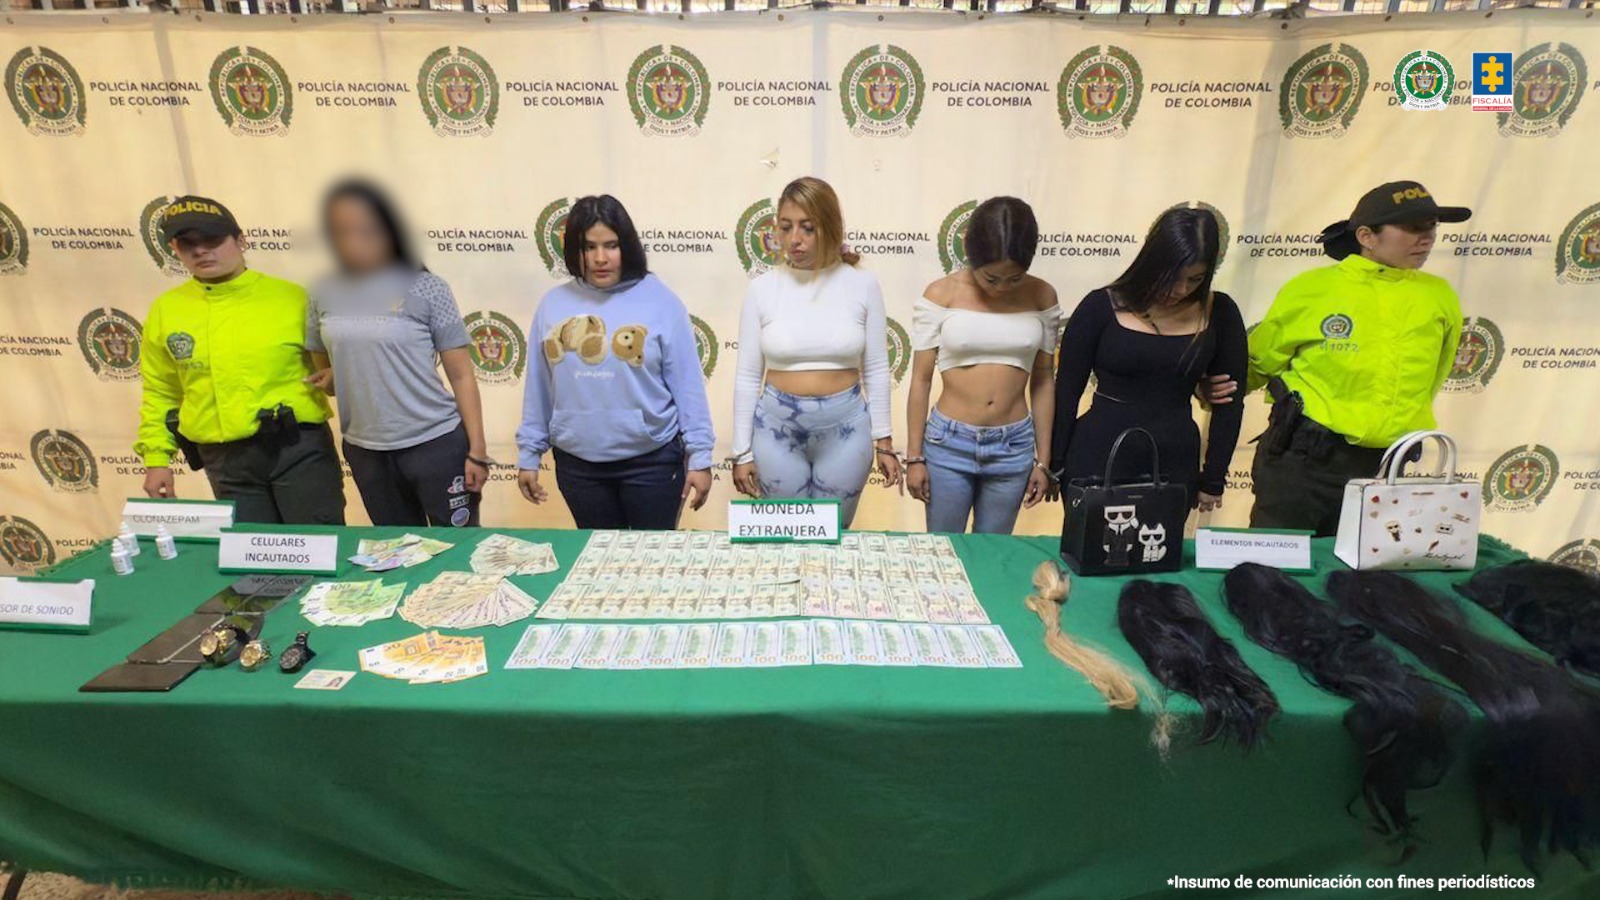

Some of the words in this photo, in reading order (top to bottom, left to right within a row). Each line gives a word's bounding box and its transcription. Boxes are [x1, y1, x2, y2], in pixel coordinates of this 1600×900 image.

[90, 80, 138, 91] POLICÍA
[141, 81, 202, 91] NACIONAL
[298, 80, 344, 92] POLICÍA
[348, 82, 410, 92] NACIONAL
[506, 80, 553, 92] POLICÍA
[556, 82, 618, 91] NACIONAL
[718, 79, 765, 91] POLICÍA
[769, 81, 831, 91] NACIONAL
[933, 79, 980, 92] POLICÍA
[985, 82, 1049, 92] NACIONAL
[1151, 80, 1201, 93] POLICÍA
[1204, 82, 1272, 93] NACIONAL
[110, 97, 125, 105] DE
[129, 96, 190, 105] COLOMBIA
[317, 97, 331, 106] DE
[334, 97, 396, 106] COLOMBIA
[524, 97, 538, 106] DE
[542, 96, 604, 106] COLOMBIA
[734, 97, 749, 106] DE
[753, 96, 816, 105] COLOMBIA
[948, 97, 963, 106] DE
[967, 97, 1032, 106] COLOMBIA
[1165, 99, 1181, 107] DE
[1185, 98, 1251, 107] COLOMBIA
[34, 226, 75, 236] POLICÍA
[79, 228, 134, 237] NACIONAL
[243, 228, 269, 238] LICÍA
[428, 228, 466, 239] OLICÍA
[469, 230, 527, 239] NACIONAL
[637, 228, 664, 239] LICÍA
[668, 231, 727, 239] NACIONAL
[870, 232, 930, 241] NACIONAL
[1037, 232, 1072, 243] OLICÍA
[1077, 234, 1137, 243] NACIONAL
[1237, 232, 1282, 244] POLICÍA
[1284, 234, 1322, 243] NACIO
[1442, 232, 1487, 242] POLICÍA
[1490, 234, 1552, 243] NACIONAL
[52, 241, 67, 249] DE
[69, 241, 123, 250] COLOMBIA
[438, 243, 452, 251] DE
[456, 243, 514, 252] COLOMBIA
[653, 244, 713, 252] COLOMBIA
[854, 245, 914, 254] COLOMBIA
[1041, 247, 1056, 256] DE
[1060, 247, 1121, 256] COLOMBIA
[1250, 248, 1264, 256] DE
[1454, 248, 1469, 256] DE
[1472, 247, 1532, 256] COLOMBIA
[19, 337, 71, 345] NACIONAL
[12, 347, 62, 356] COLOMBIA
[1511, 346, 1555, 356] POLICÍA
[1559, 348, 1600, 356] NACION
[1523, 360, 1537, 368] DE
[1541, 360, 1596, 368] COLOMBIA
[101, 454, 140, 464] POLICÍA
[1574, 482, 1588, 490] DE
[751, 503, 814, 515] MONEDA
[133, 515, 200, 524] CLONAZEPAM
[739, 525, 826, 536] EXTRANJERA
[251, 537, 305, 547] CELULARES
[1254, 541, 1298, 549] INCAUTADOS
[245, 553, 310, 563] INCAUTADOS
[36, 606, 74, 615] SONIDO
[684, 657, 707, 665] 100
[720, 656, 742, 664] 100
[754, 656, 776, 664] 100
[820, 654, 843, 662] 100
[922, 656, 946, 664] 100
